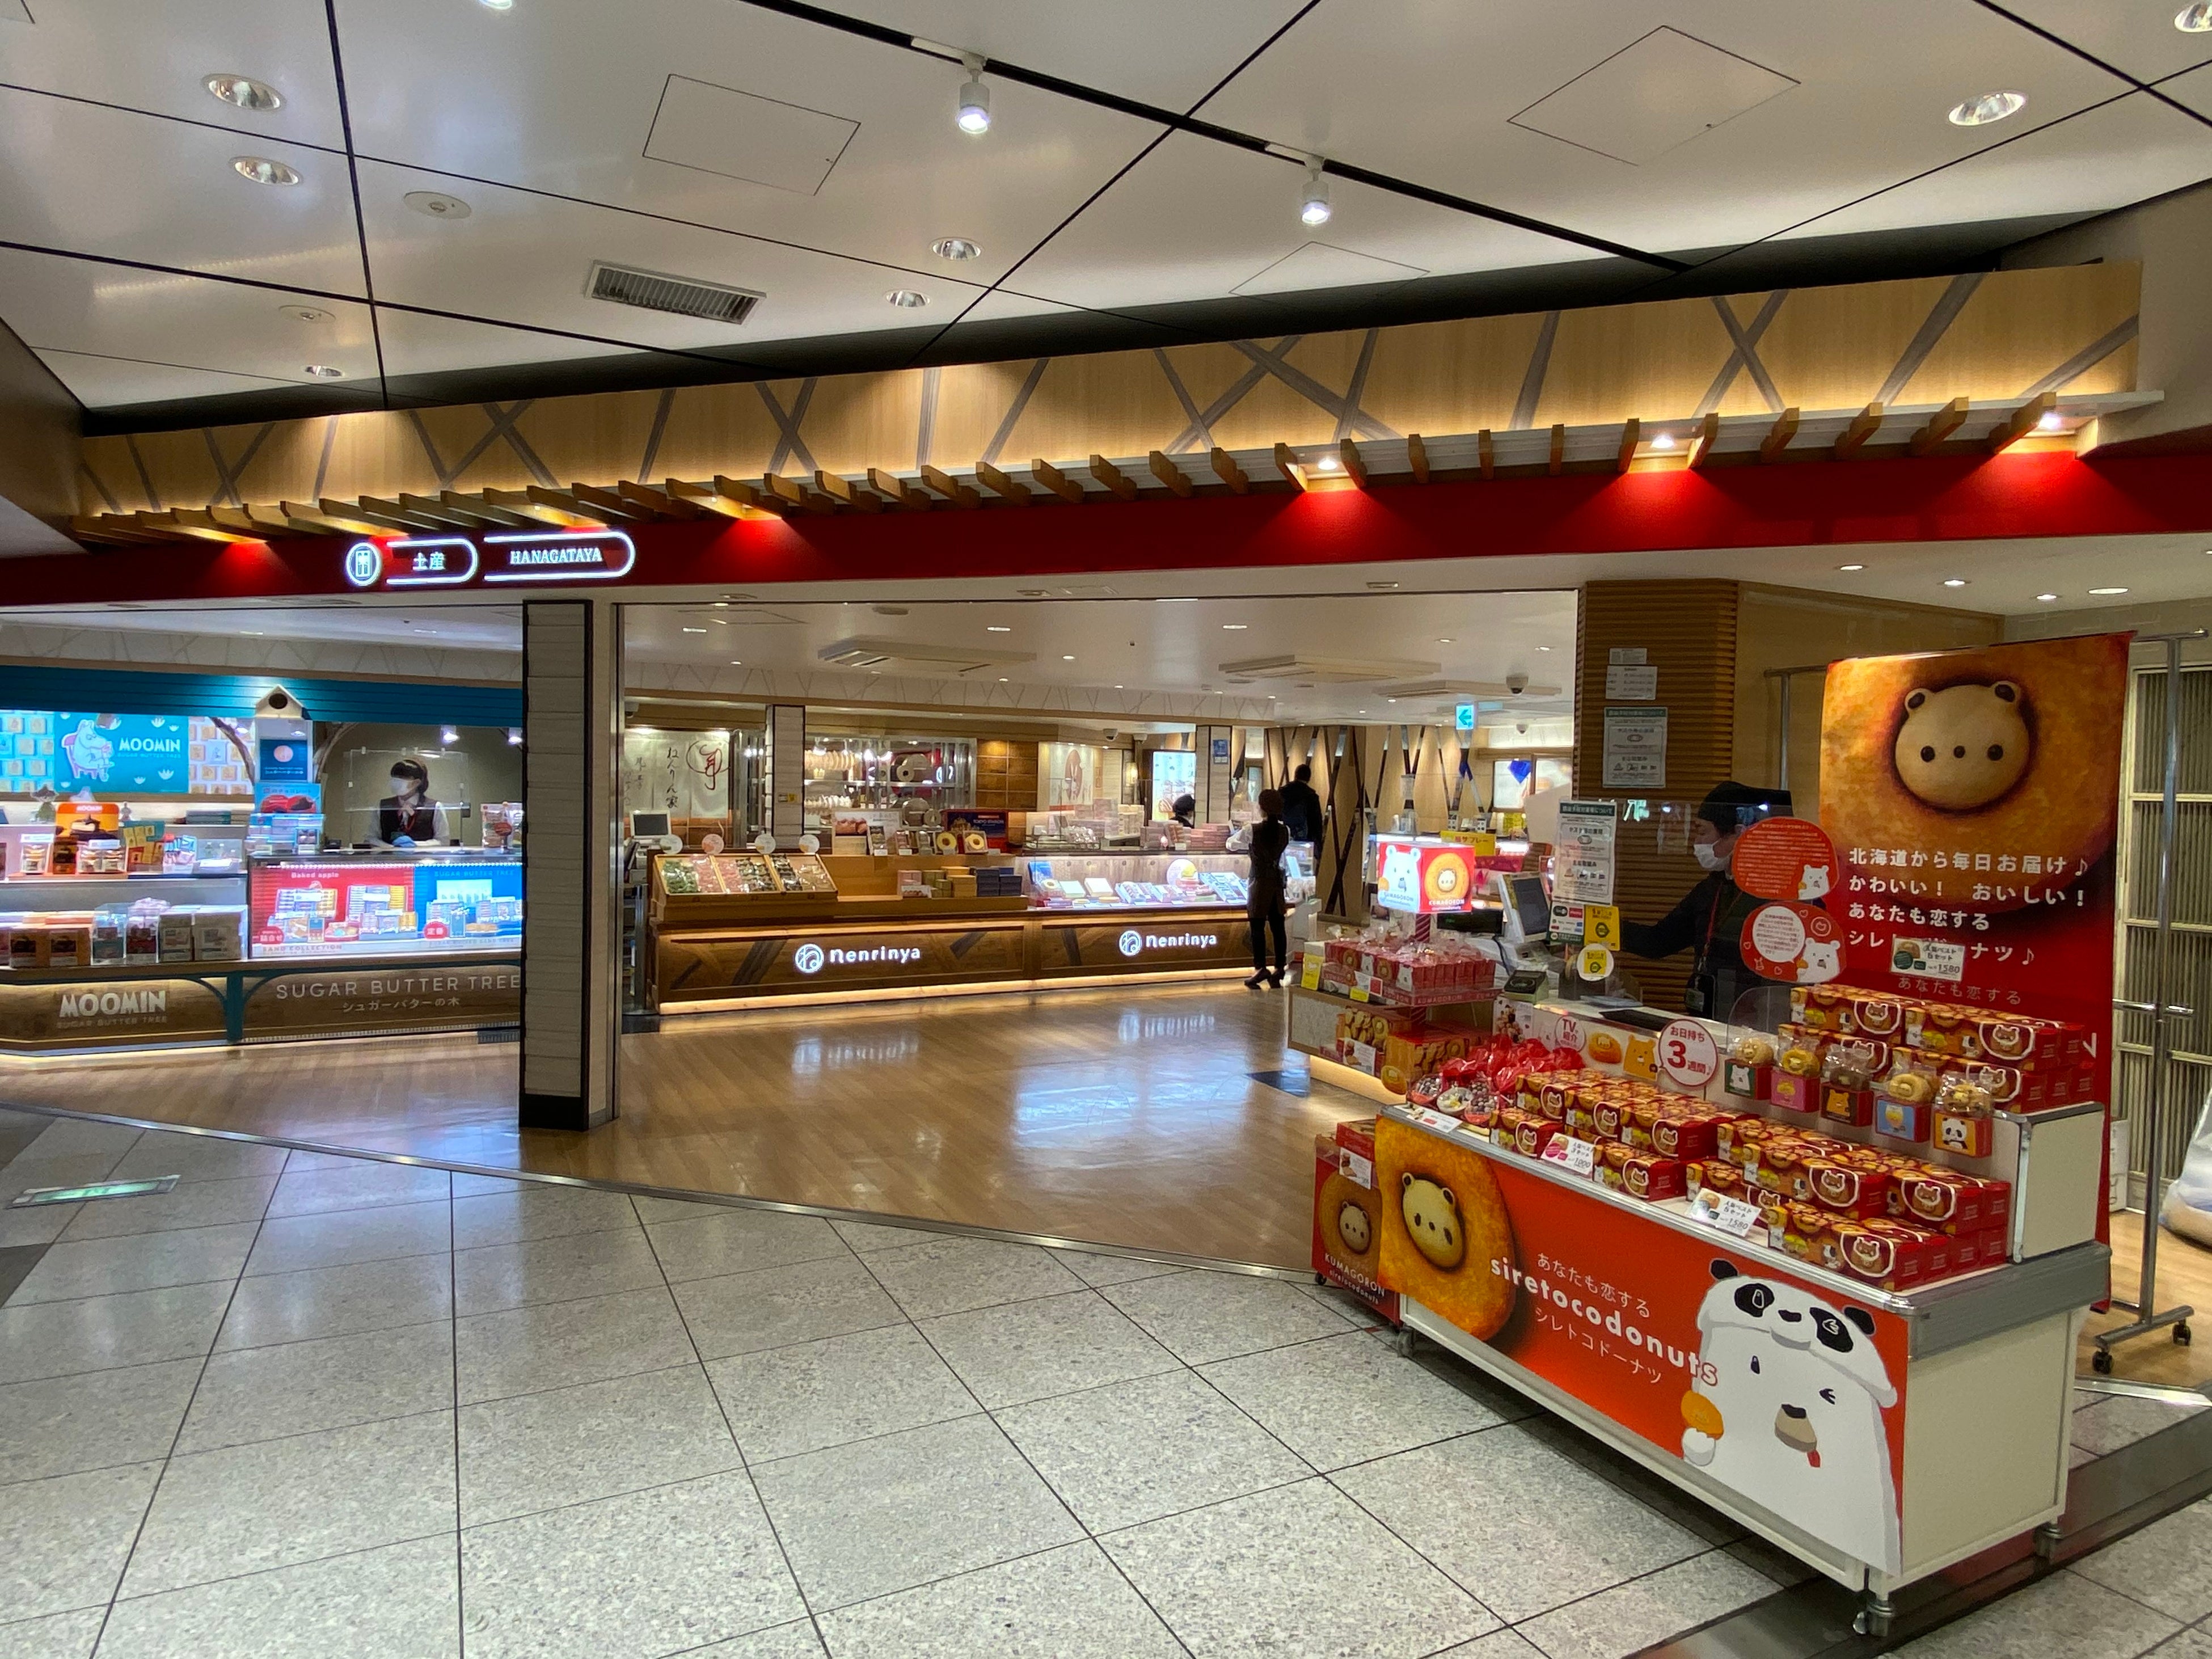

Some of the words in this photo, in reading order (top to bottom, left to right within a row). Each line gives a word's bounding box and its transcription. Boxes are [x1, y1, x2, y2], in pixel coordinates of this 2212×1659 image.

[412, 551, 446, 570] 土産
[510, 547, 603, 564] HANAGATAYA
[119, 737, 180, 753] MOOMIN
[1848, 902, 1990, 930] あなたも恋する
[1939, 964, 1960, 973] 1580
[276, 982, 357, 999] SUGAR
[371, 977, 458, 994] BUTTER
[468, 975, 520, 990] TREE
[1898, 977, 2021, 1005] あなたも恋する
[60, 990, 166, 1018] MOOMIN
[343, 997, 460, 1012] シュガーバターの木
[1670, 1025, 1705, 1042] お日持ち
[1668, 1040, 1686, 1068] 3
[1729, 1218, 1748, 1230] 1580
[1325, 1253, 1384, 1297] KUMAGORON
[1537, 1252, 1650, 1318] あなたも恋する
[1491, 1257, 1718, 1386] siretocodonuts
[1535, 1307, 1661, 1383] シレトコドーナツ
